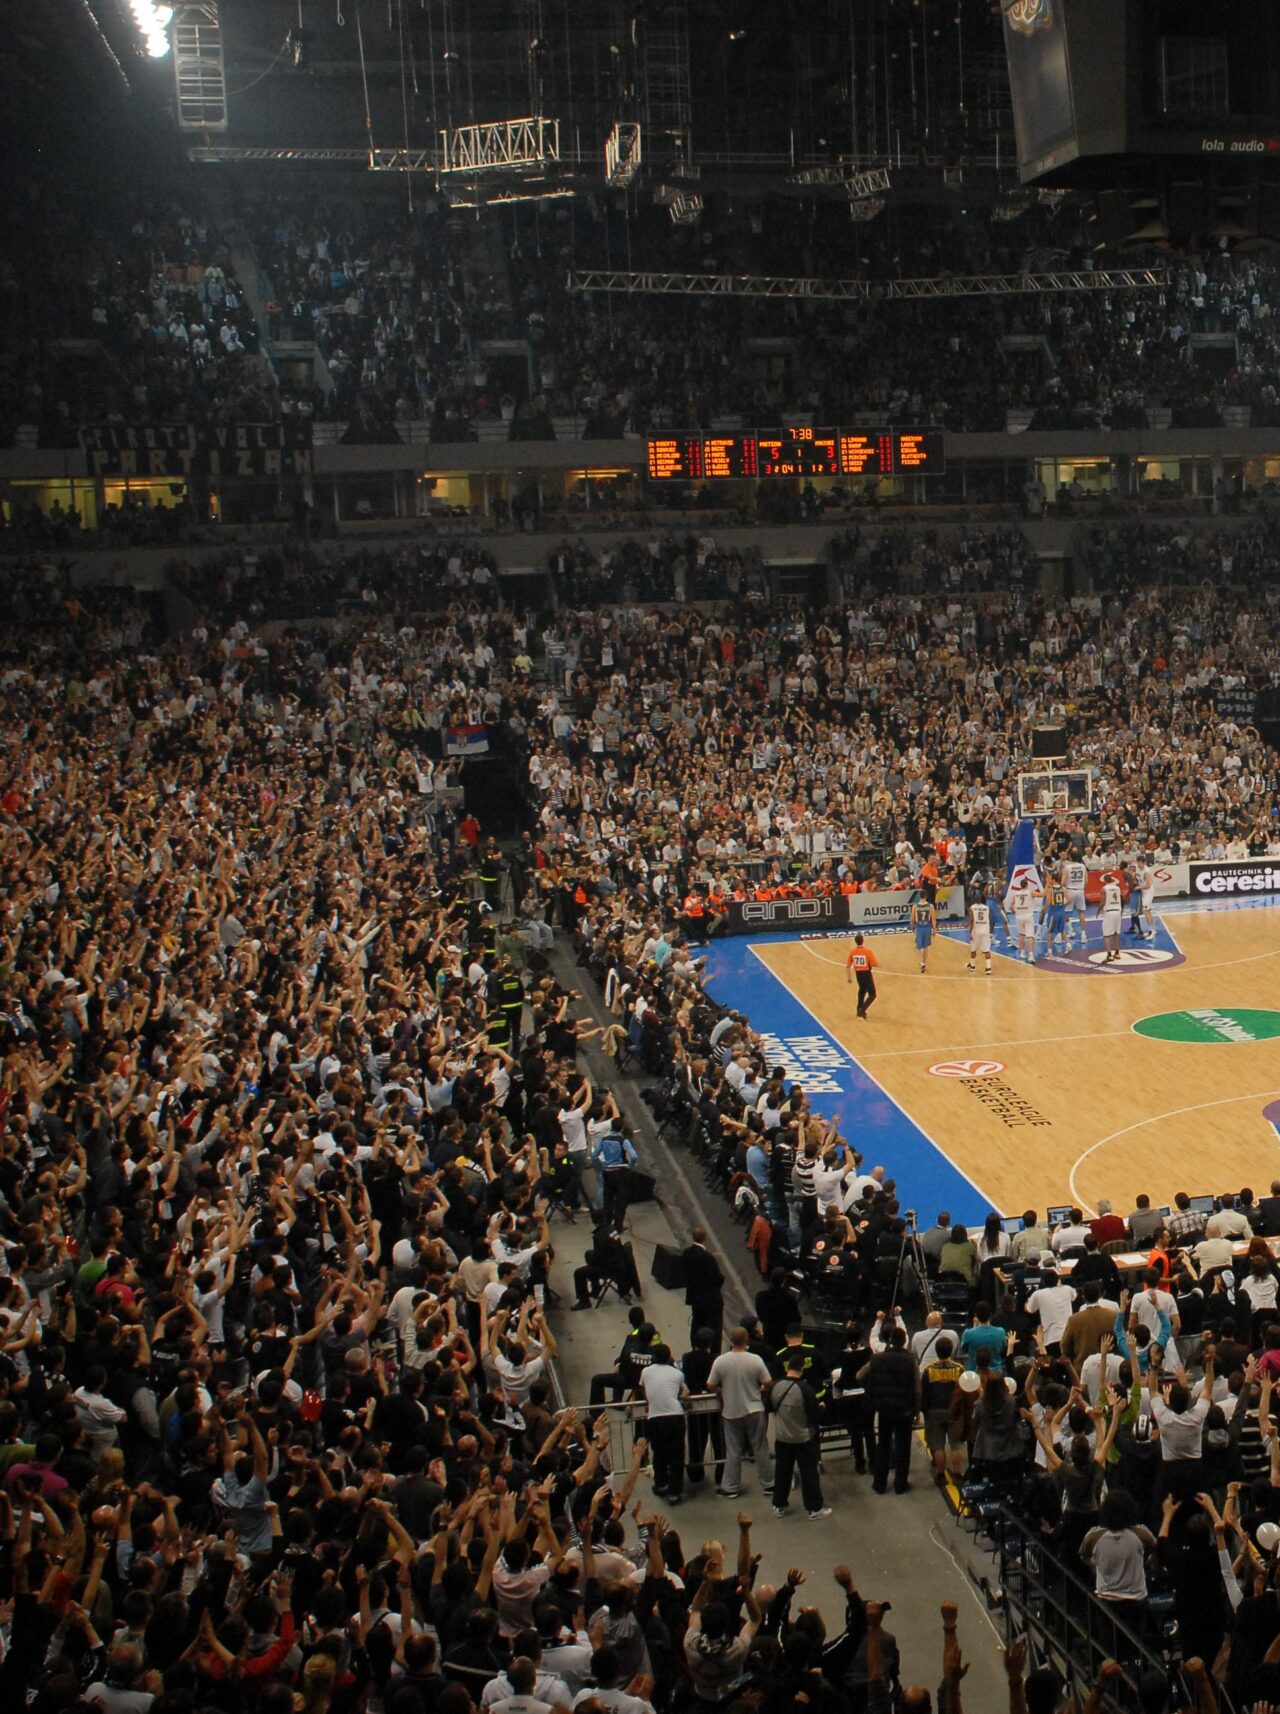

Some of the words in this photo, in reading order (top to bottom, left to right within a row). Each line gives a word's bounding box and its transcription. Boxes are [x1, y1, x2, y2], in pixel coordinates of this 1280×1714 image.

[1230, 139, 1265, 152] audio
[789, 428, 813, 440] 7:38
[92, 449, 312, 475] PARTIZAN
[1070, 871, 1083, 879] 33
[1211, 868, 1264, 877] BAUTECHNIK
[864, 901, 948, 916] AUSTROTRM
[920, 911, 927, 921] 7
[978, 911, 984, 921] 6
[854, 956, 865, 966] 70
[783, 1035, 851, 1069] ARENA
[959, 1078, 1027, 1129] BASKETBALL
[981, 1076, 1053, 1128] EUROLEAGUE
